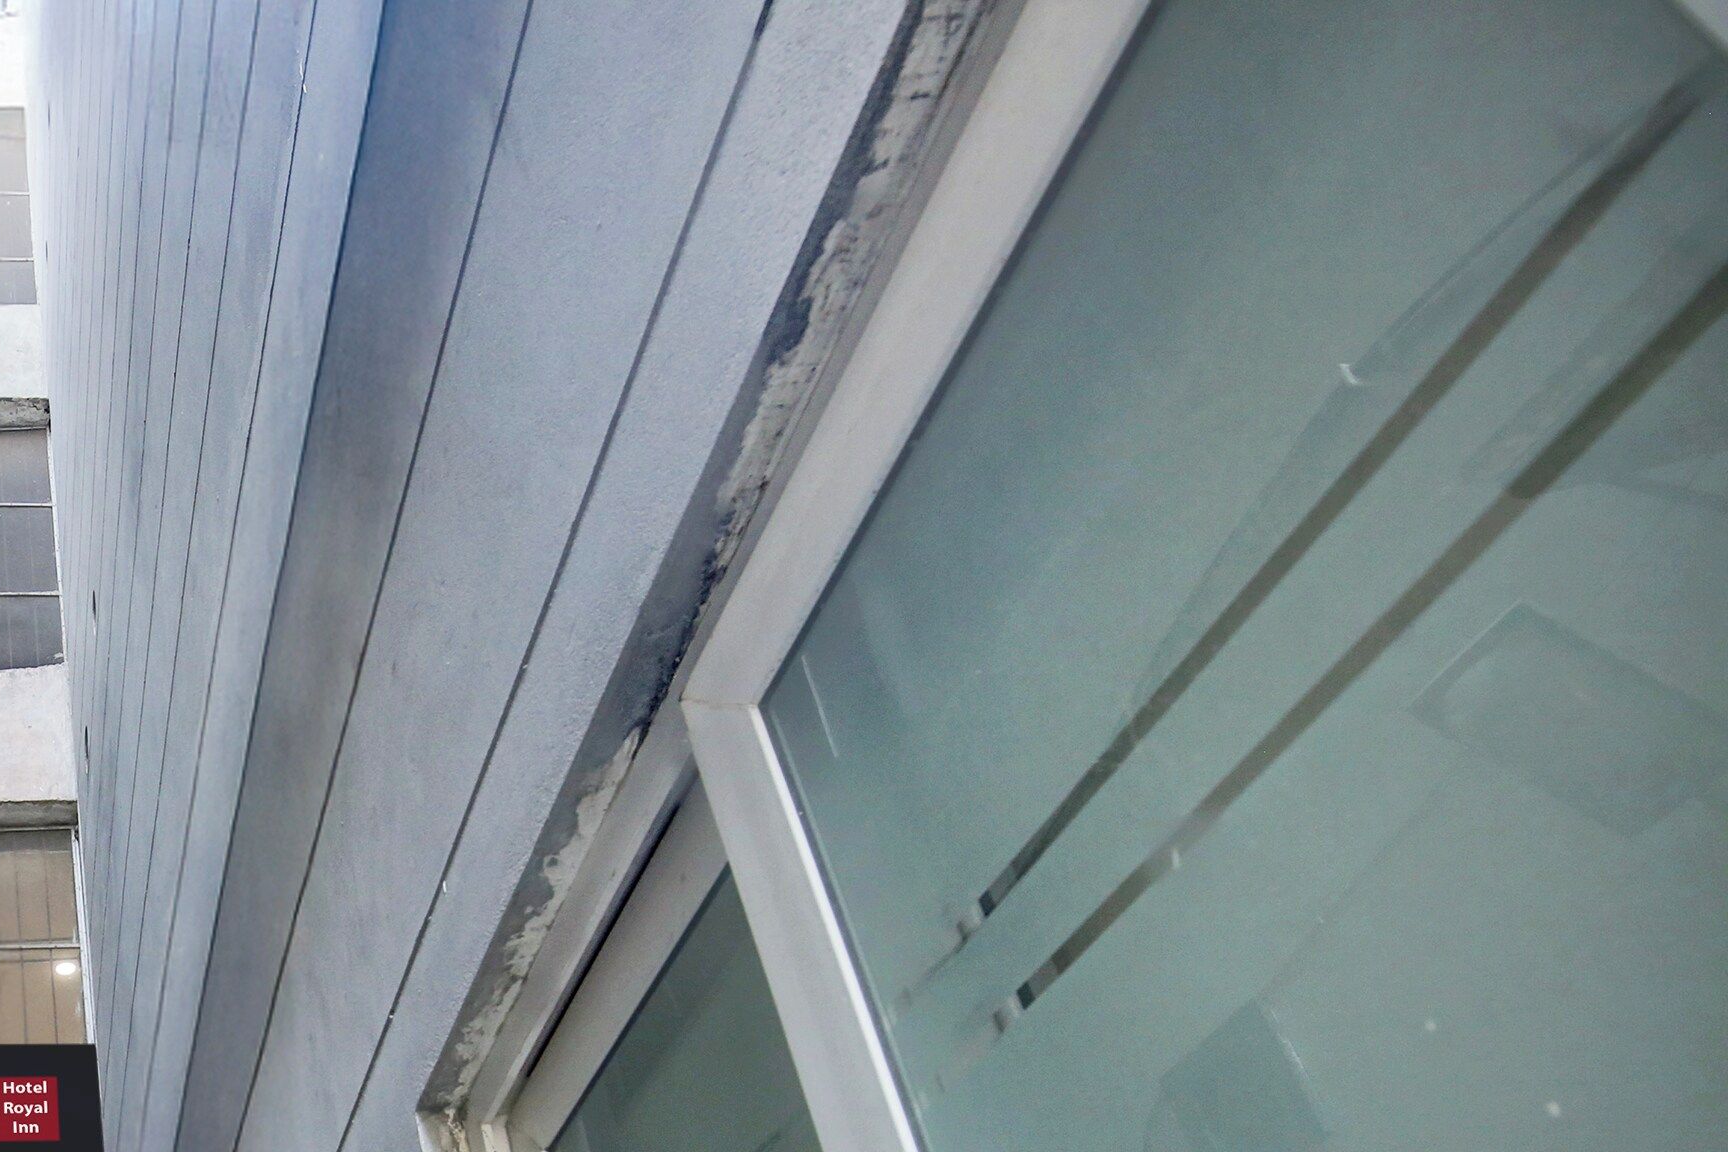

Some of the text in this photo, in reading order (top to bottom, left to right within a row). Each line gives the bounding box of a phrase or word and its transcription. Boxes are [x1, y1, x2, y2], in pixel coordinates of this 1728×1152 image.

[2, 1080, 48, 1094] Hotel
[3, 1100, 49, 1117] Royal
[13, 1121, 40, 1134] Inn
